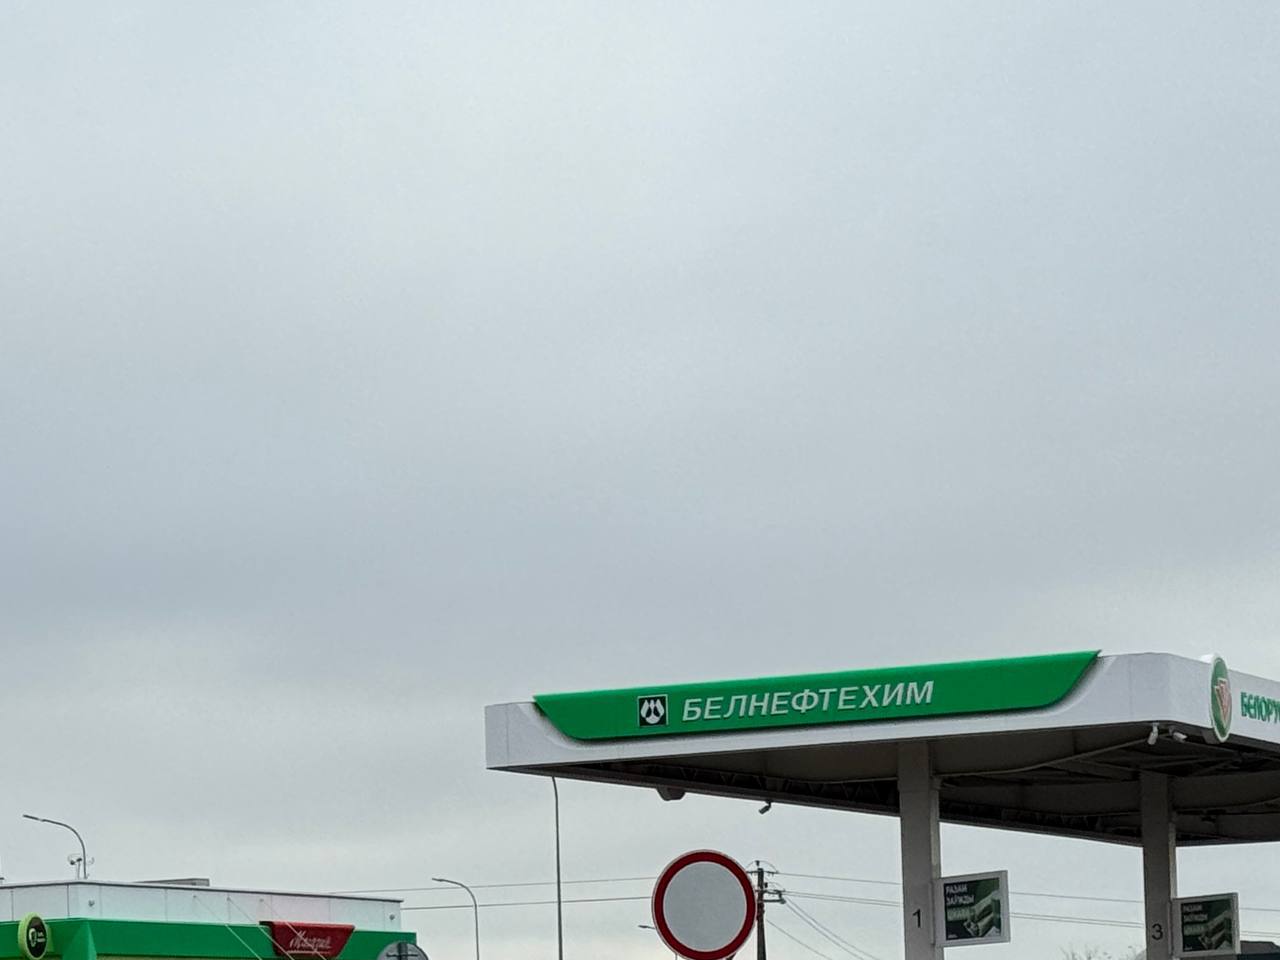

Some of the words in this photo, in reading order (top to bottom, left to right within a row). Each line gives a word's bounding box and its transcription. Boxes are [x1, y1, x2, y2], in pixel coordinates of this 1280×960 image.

[682, 681, 934, 721] БЕЛНЕФТЕХИМ
[1240, 692, 1280, 724] БЕЛОРУ
[912, 908, 921, 928] 1
[1151, 923, 1163, 940] 3
